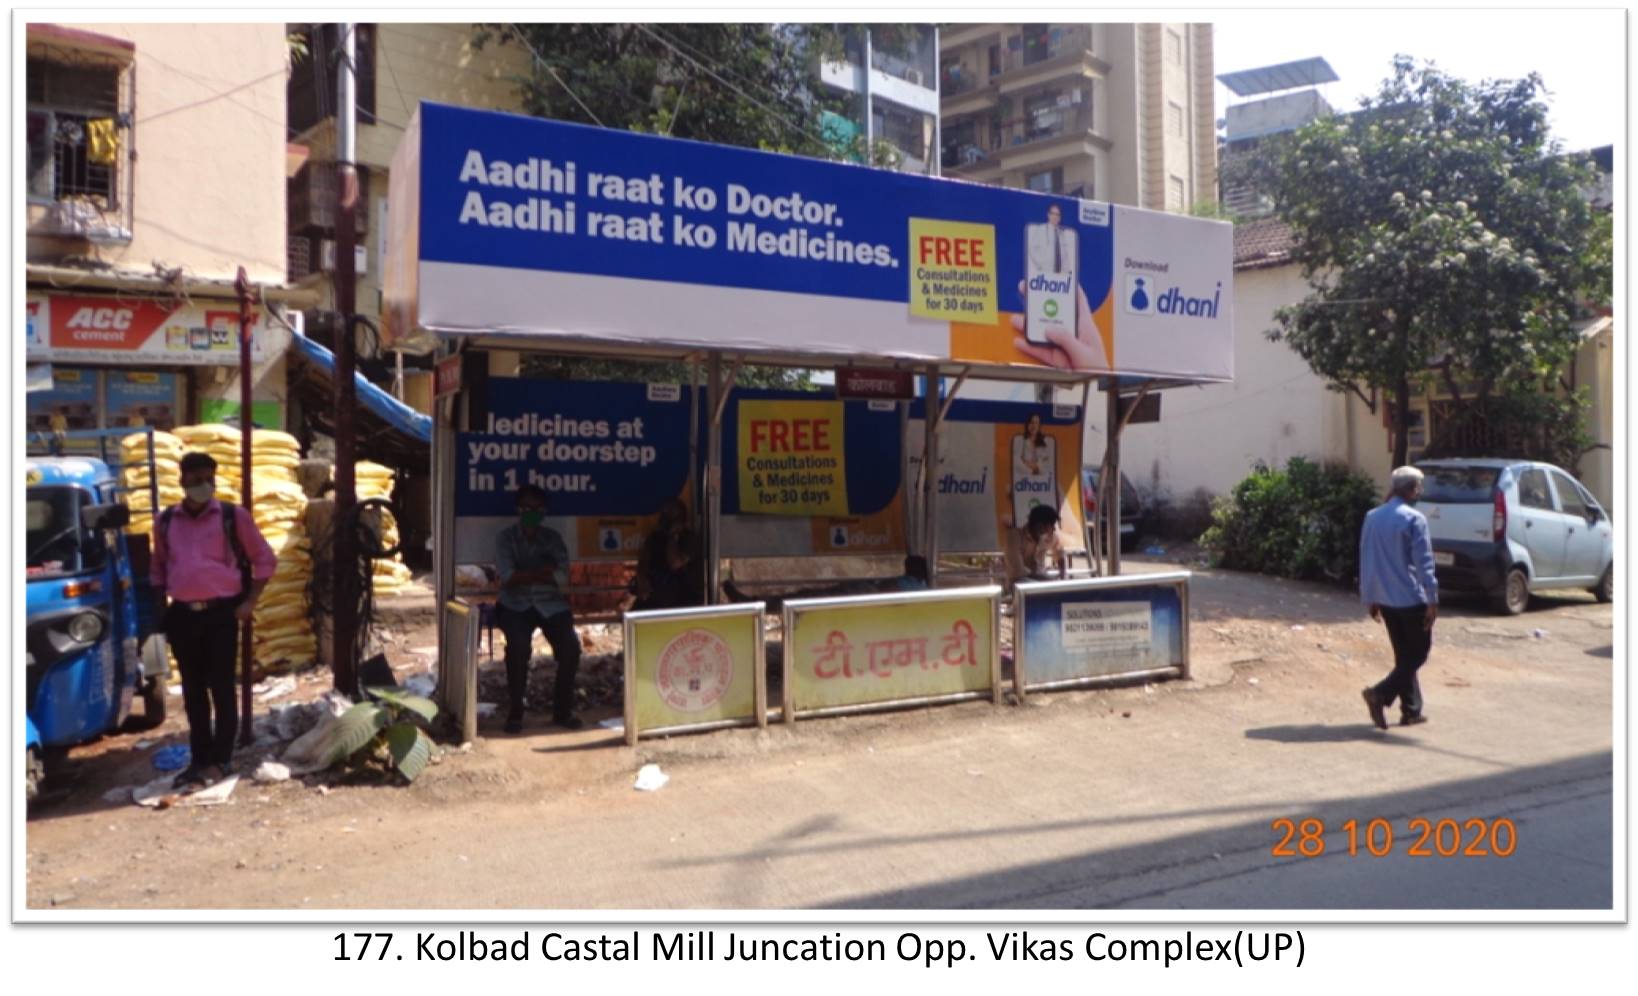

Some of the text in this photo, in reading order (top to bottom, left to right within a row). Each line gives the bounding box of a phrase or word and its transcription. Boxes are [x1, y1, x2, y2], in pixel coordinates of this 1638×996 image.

[459, 150, 844, 227] Aadhi raat ko Doctor.
[459, 192, 899, 268] Aadhi raat ko Medicines.
[919, 235, 985, 267] FREE
[1124, 257, 1169, 273] Download
[916, 268, 991, 284] Consultations
[1029, 270, 1072, 295] dhani
[922, 284, 988, 298] & Medicines
[1156, 280, 1222, 319] dhani
[926, 297, 984, 313] for 30 days
[66, 307, 134, 330] ACC
[72, 330, 126, 342] cement
[617, 417, 644, 438] at
[750, 419, 831, 453] FREE
[468, 439, 657, 467] your doorstep
[746, 455, 837, 471] Consultations
[469, 469, 597, 491] in 1 hour.
[752, 473, 834, 488] & Medicines
[1015, 473, 1053, 493] dhani
[758, 489, 831, 505] for 30 days
